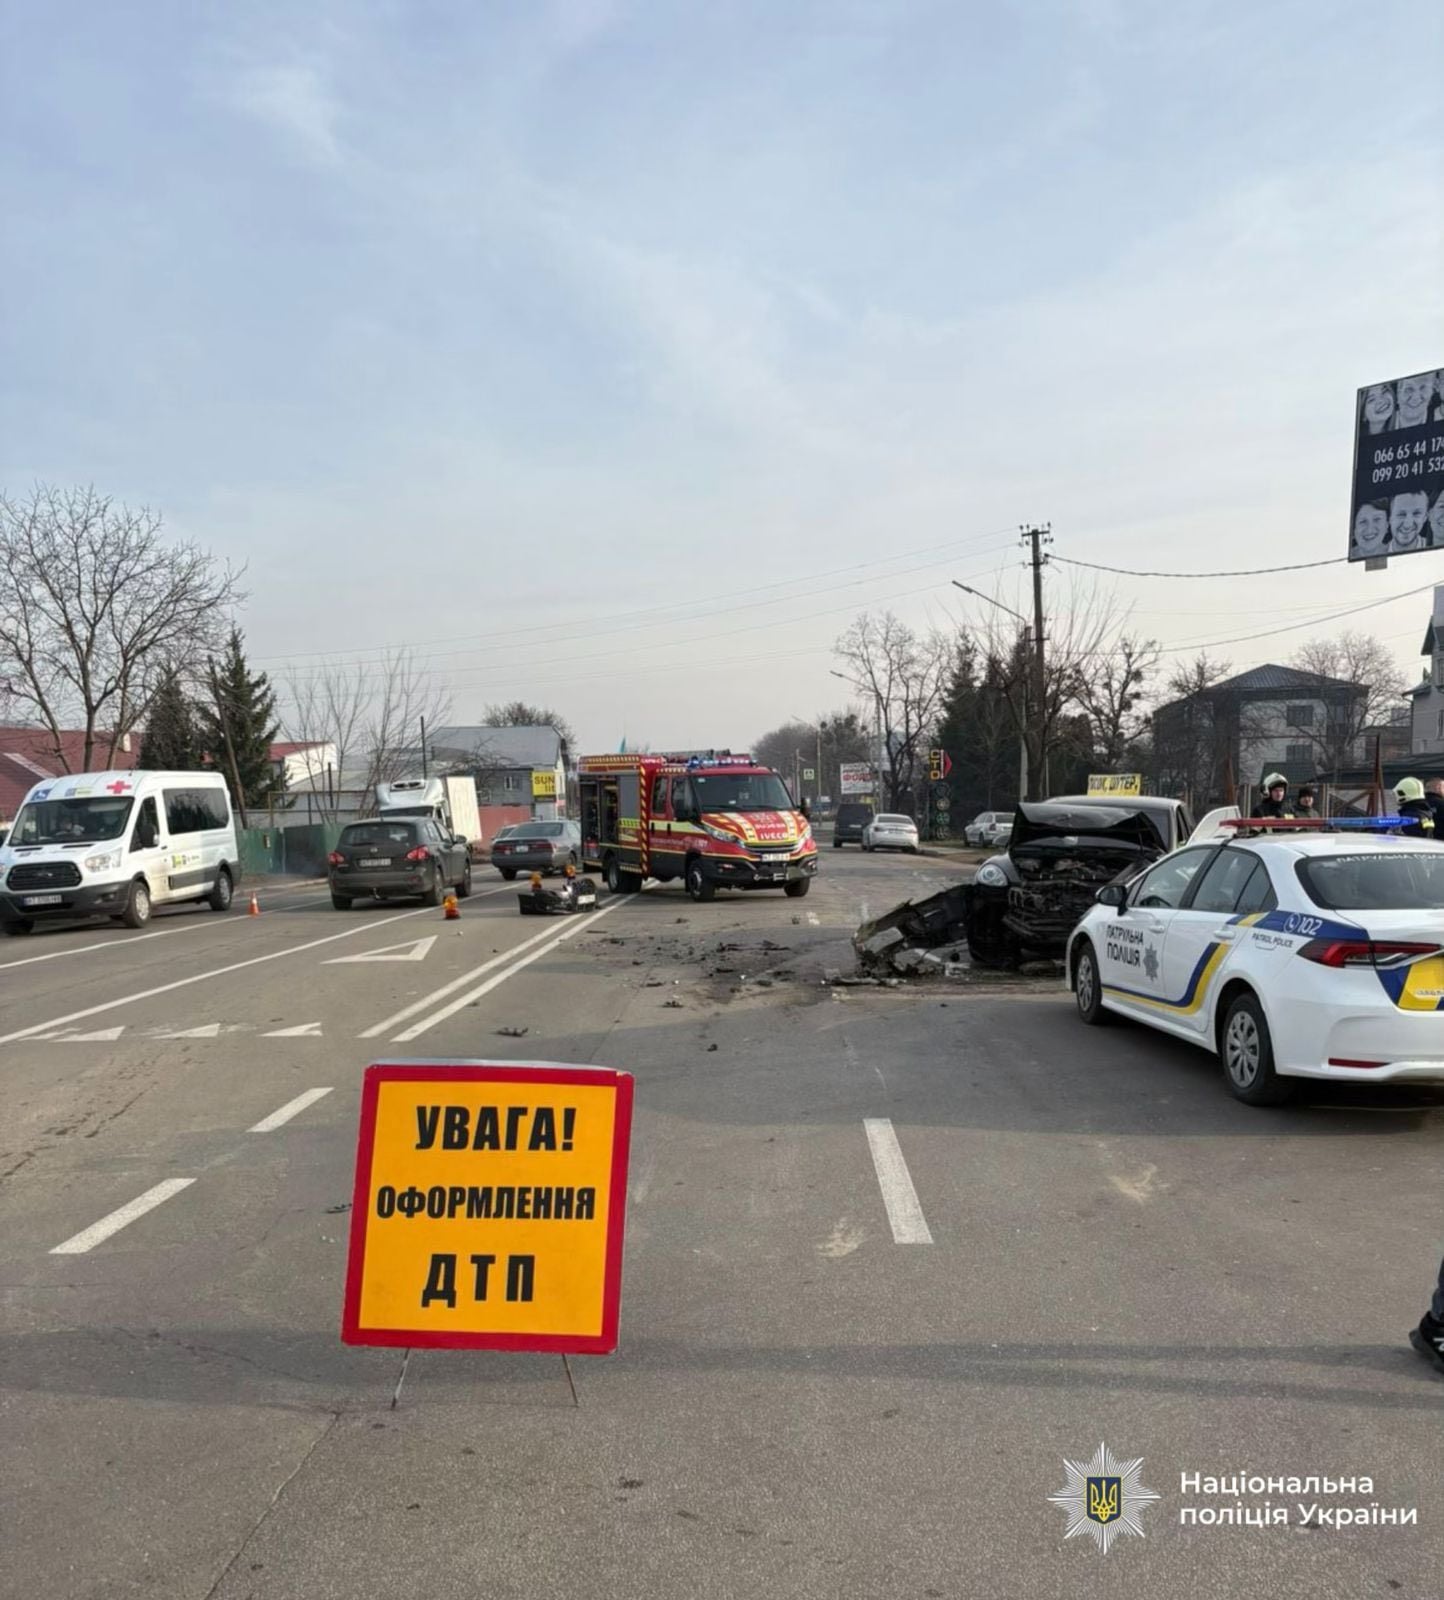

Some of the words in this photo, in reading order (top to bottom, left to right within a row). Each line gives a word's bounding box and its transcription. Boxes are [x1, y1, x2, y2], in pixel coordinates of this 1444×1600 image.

[1374, 446, 1394, 465] 066
[1396, 443, 1410, 460] 65
[1412, 440, 1426, 456] 44
[1372, 466, 1393, 483] 099
[1395, 463, 1409, 479] 20
[1411, 460, 1423, 475] 41
[760, 832, 788, 840] IVECO
[1106, 924, 1144, 945] ПАТРУЛЬНА
[1298, 916, 1323, 936] 102
[1252, 932, 1272, 944] PATROL
[1273, 936, 1294, 948] POLICE
[1106, 942, 1141, 967] ПОЛІЦІЯ
[415, 1106, 576, 1151] УВАГА!
[377, 1186, 596, 1220] ОФОРМЛЕННЯ
[421, 1253, 535, 1308] ДТП
